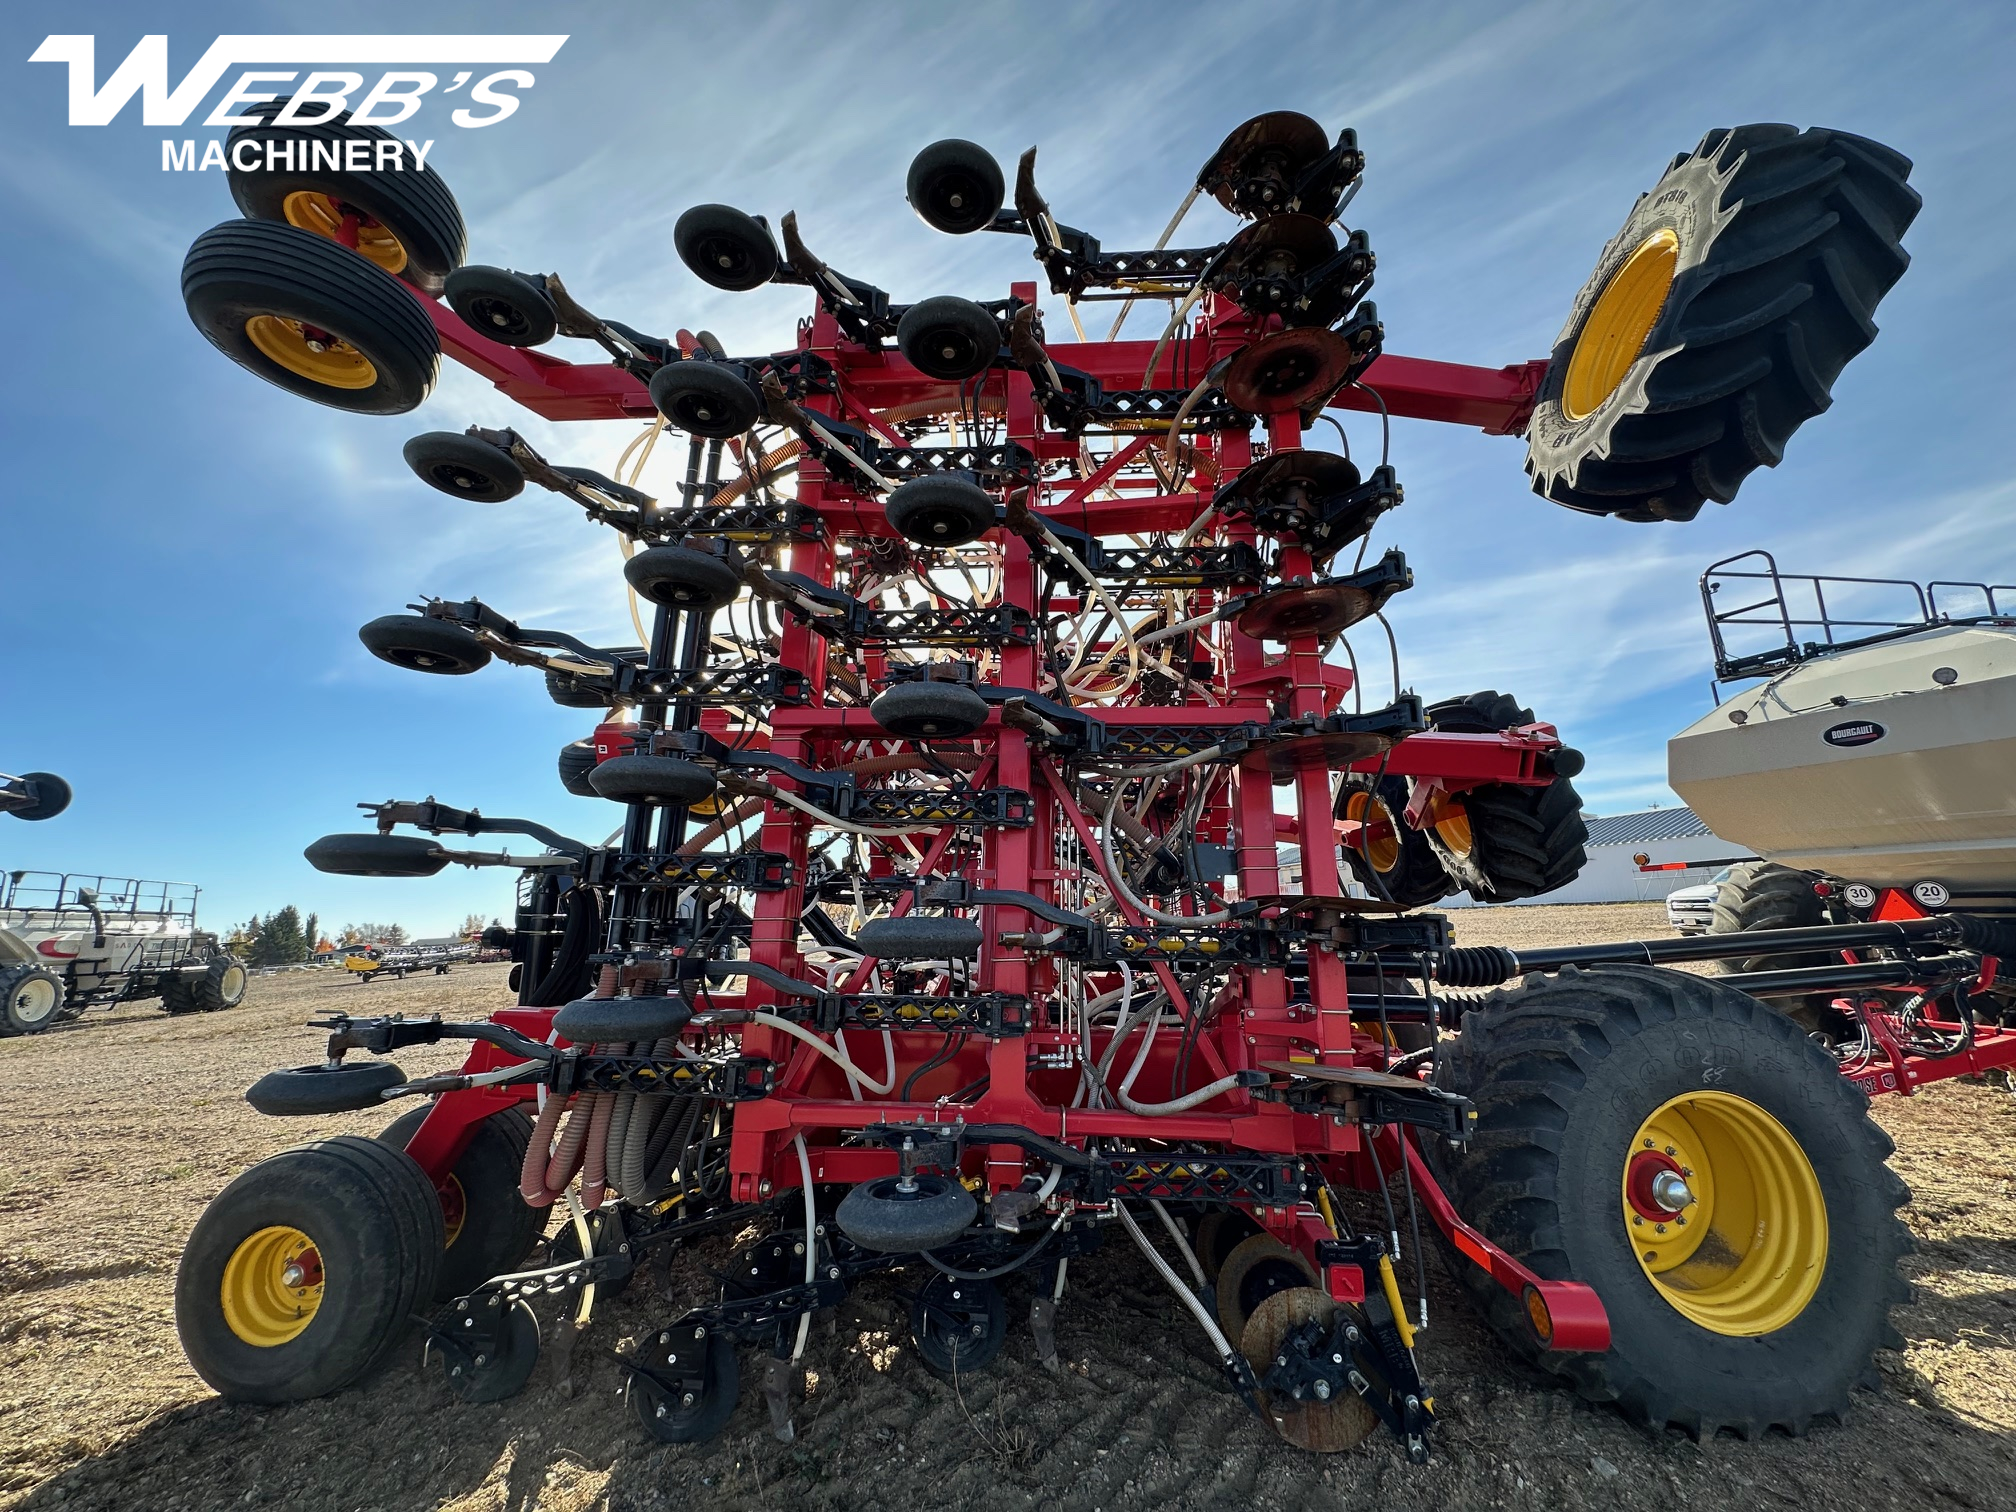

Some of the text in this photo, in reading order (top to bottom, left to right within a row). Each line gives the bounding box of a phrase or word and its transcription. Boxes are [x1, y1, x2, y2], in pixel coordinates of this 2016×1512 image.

[1831, 724, 1873, 740] BOURGAULT
[1849, 888, 1869, 899] 30
[1919, 885, 1941, 897] 20
